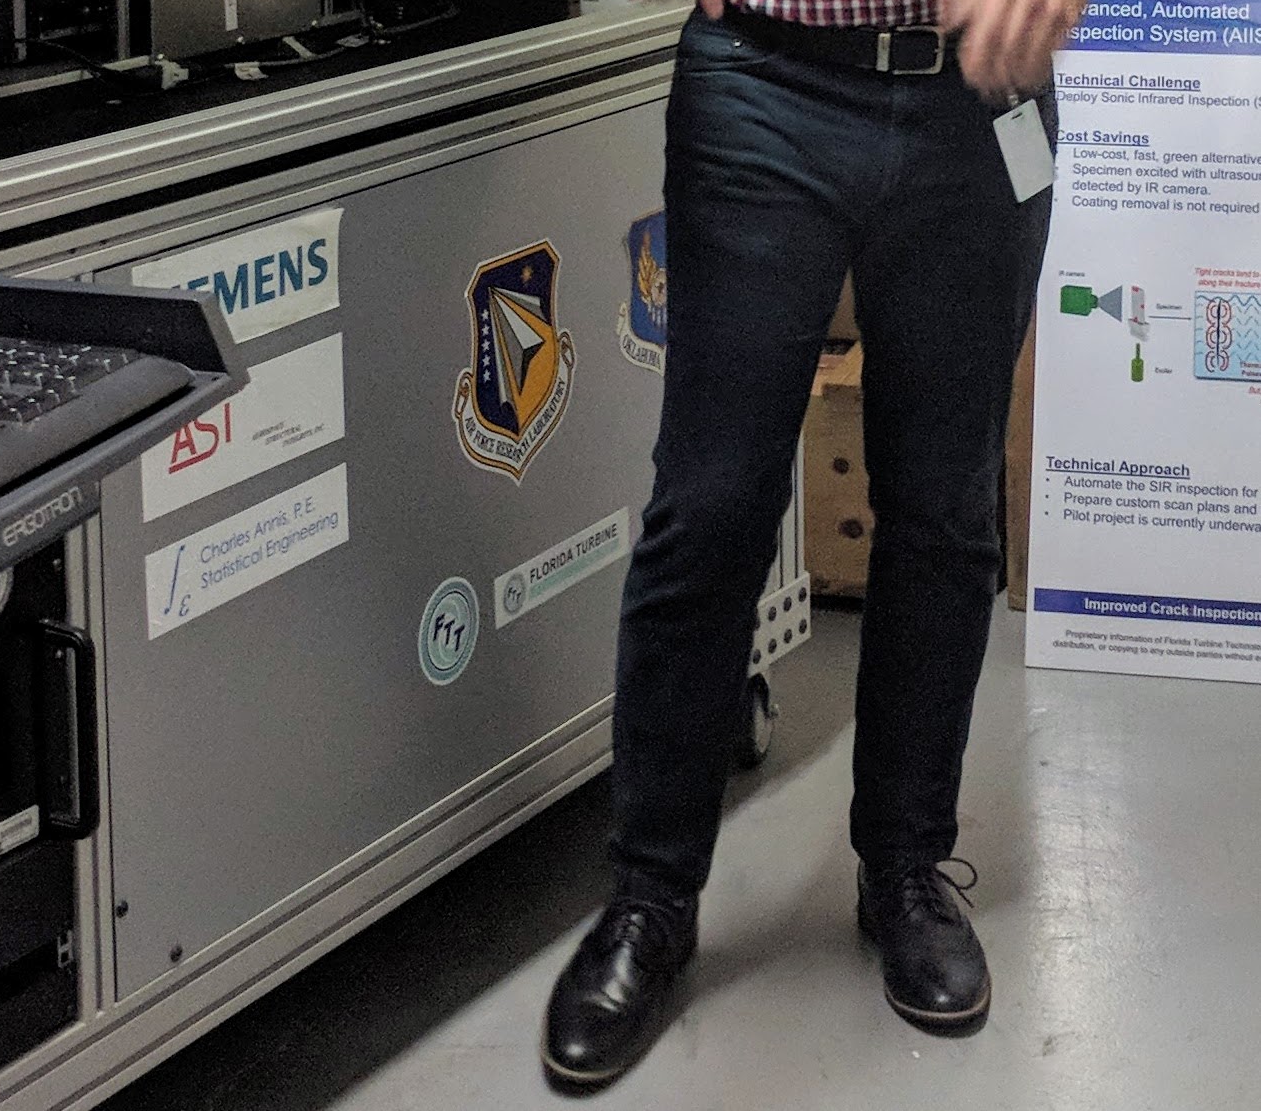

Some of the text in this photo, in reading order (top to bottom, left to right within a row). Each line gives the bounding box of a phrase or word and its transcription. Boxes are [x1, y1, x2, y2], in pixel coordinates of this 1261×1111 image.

[1152, 1, 1250, 20] Automated
[1069, 24, 1144, 43] spection
[1149, 24, 1216, 46] System
[1056, 73, 1201, 90] Technical Challenge
[1056, 90, 1098, 104] Deploy
[1101, 91, 1135, 103] Sonic
[1138, 92, 1184, 105] Infrared
[1188, 94, 1250, 108] Inspection
[1092, 130, 1150, 146] Savings
[1073, 148, 1130, 162] Low-cost,
[1163, 152, 1198, 164] green
[1072, 164, 1133, 178] Specimen
[1135, 165, 1179, 178] excited
[1181, 167, 1207, 180] with
[1071, 180, 1211, 196] detected by IR camera.
[1071, 195, 1260, 215] Coating removal is not required
[1045, 456, 1190, 477] Technical Approach
[1064, 476, 1258, 498] Automate the SIR inspection for
[1063, 492, 1257, 515] Prepare custom scan plans and
[1063, 509, 1261, 533] Pilot project is currently underwa
[200, 529, 250, 564] Charles
[200, 512, 339, 589] Statistical Engineering
[528, 523, 618, 584] FLORIDA TURBINE
[1084, 597, 1147, 614] Improved
[1150, 601, 1189, 617] Crack
[432, 612, 466, 652] FTT
